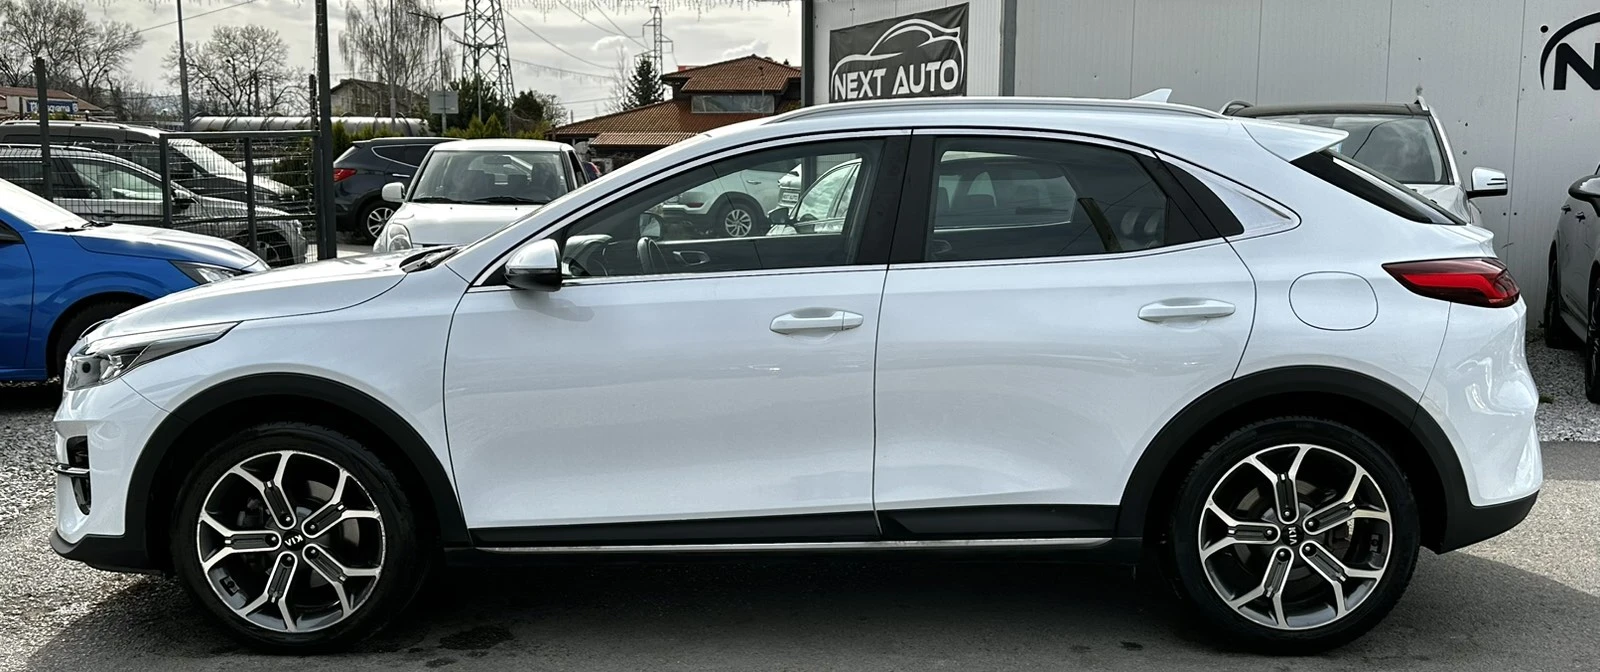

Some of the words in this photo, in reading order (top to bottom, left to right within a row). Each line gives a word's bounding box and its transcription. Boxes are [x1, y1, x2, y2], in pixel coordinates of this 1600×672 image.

[835, 68, 887, 100] NEXT
[892, 59, 959, 95] AUTO
[284, 534, 304, 546] KIA
[1288, 527, 1297, 545] KIA
